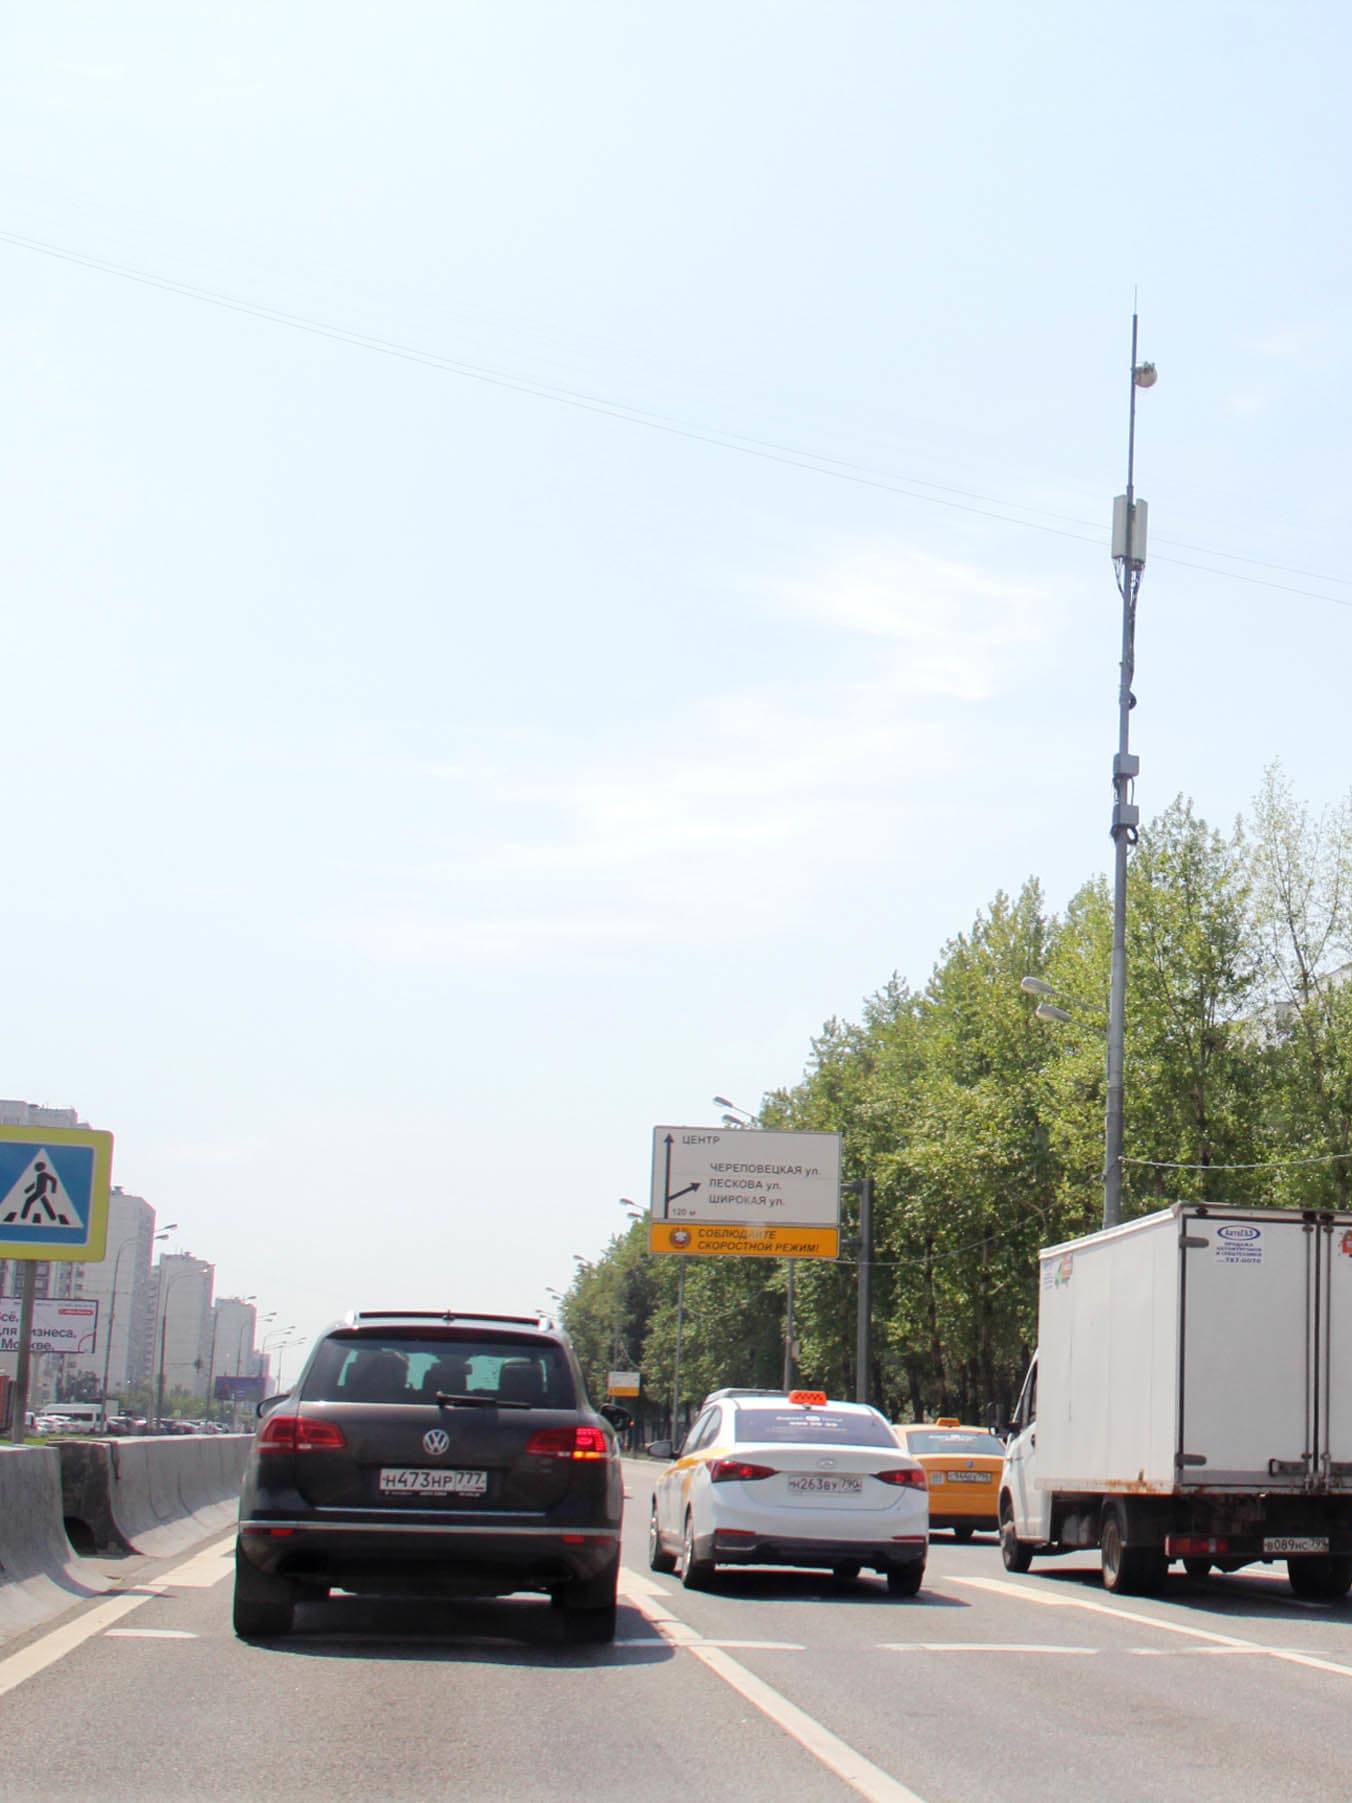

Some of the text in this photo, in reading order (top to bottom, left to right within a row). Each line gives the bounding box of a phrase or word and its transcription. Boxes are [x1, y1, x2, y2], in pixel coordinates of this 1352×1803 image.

[682, 1135, 721, 1145] ЦЕНТР
[710, 1163, 822, 1177] ЧЕРЕПОВЕЦКАЯ ул.
[708, 1178, 783, 1192] ЛЕСКОВА ул.
[708, 1194, 786, 1208] ШИРОКАЯ ул.
[697, 1240, 773, 1252] СКОРОСТНОЙ
[0, 1311, 19, 1322] сё.
[0, 1327, 18, 1336] ля
[29, 1328, 77, 1338] изнеса.
[1, 1338, 55, 1351] Мокве.
[384, 1471, 483, 1488] Н473НР 777
